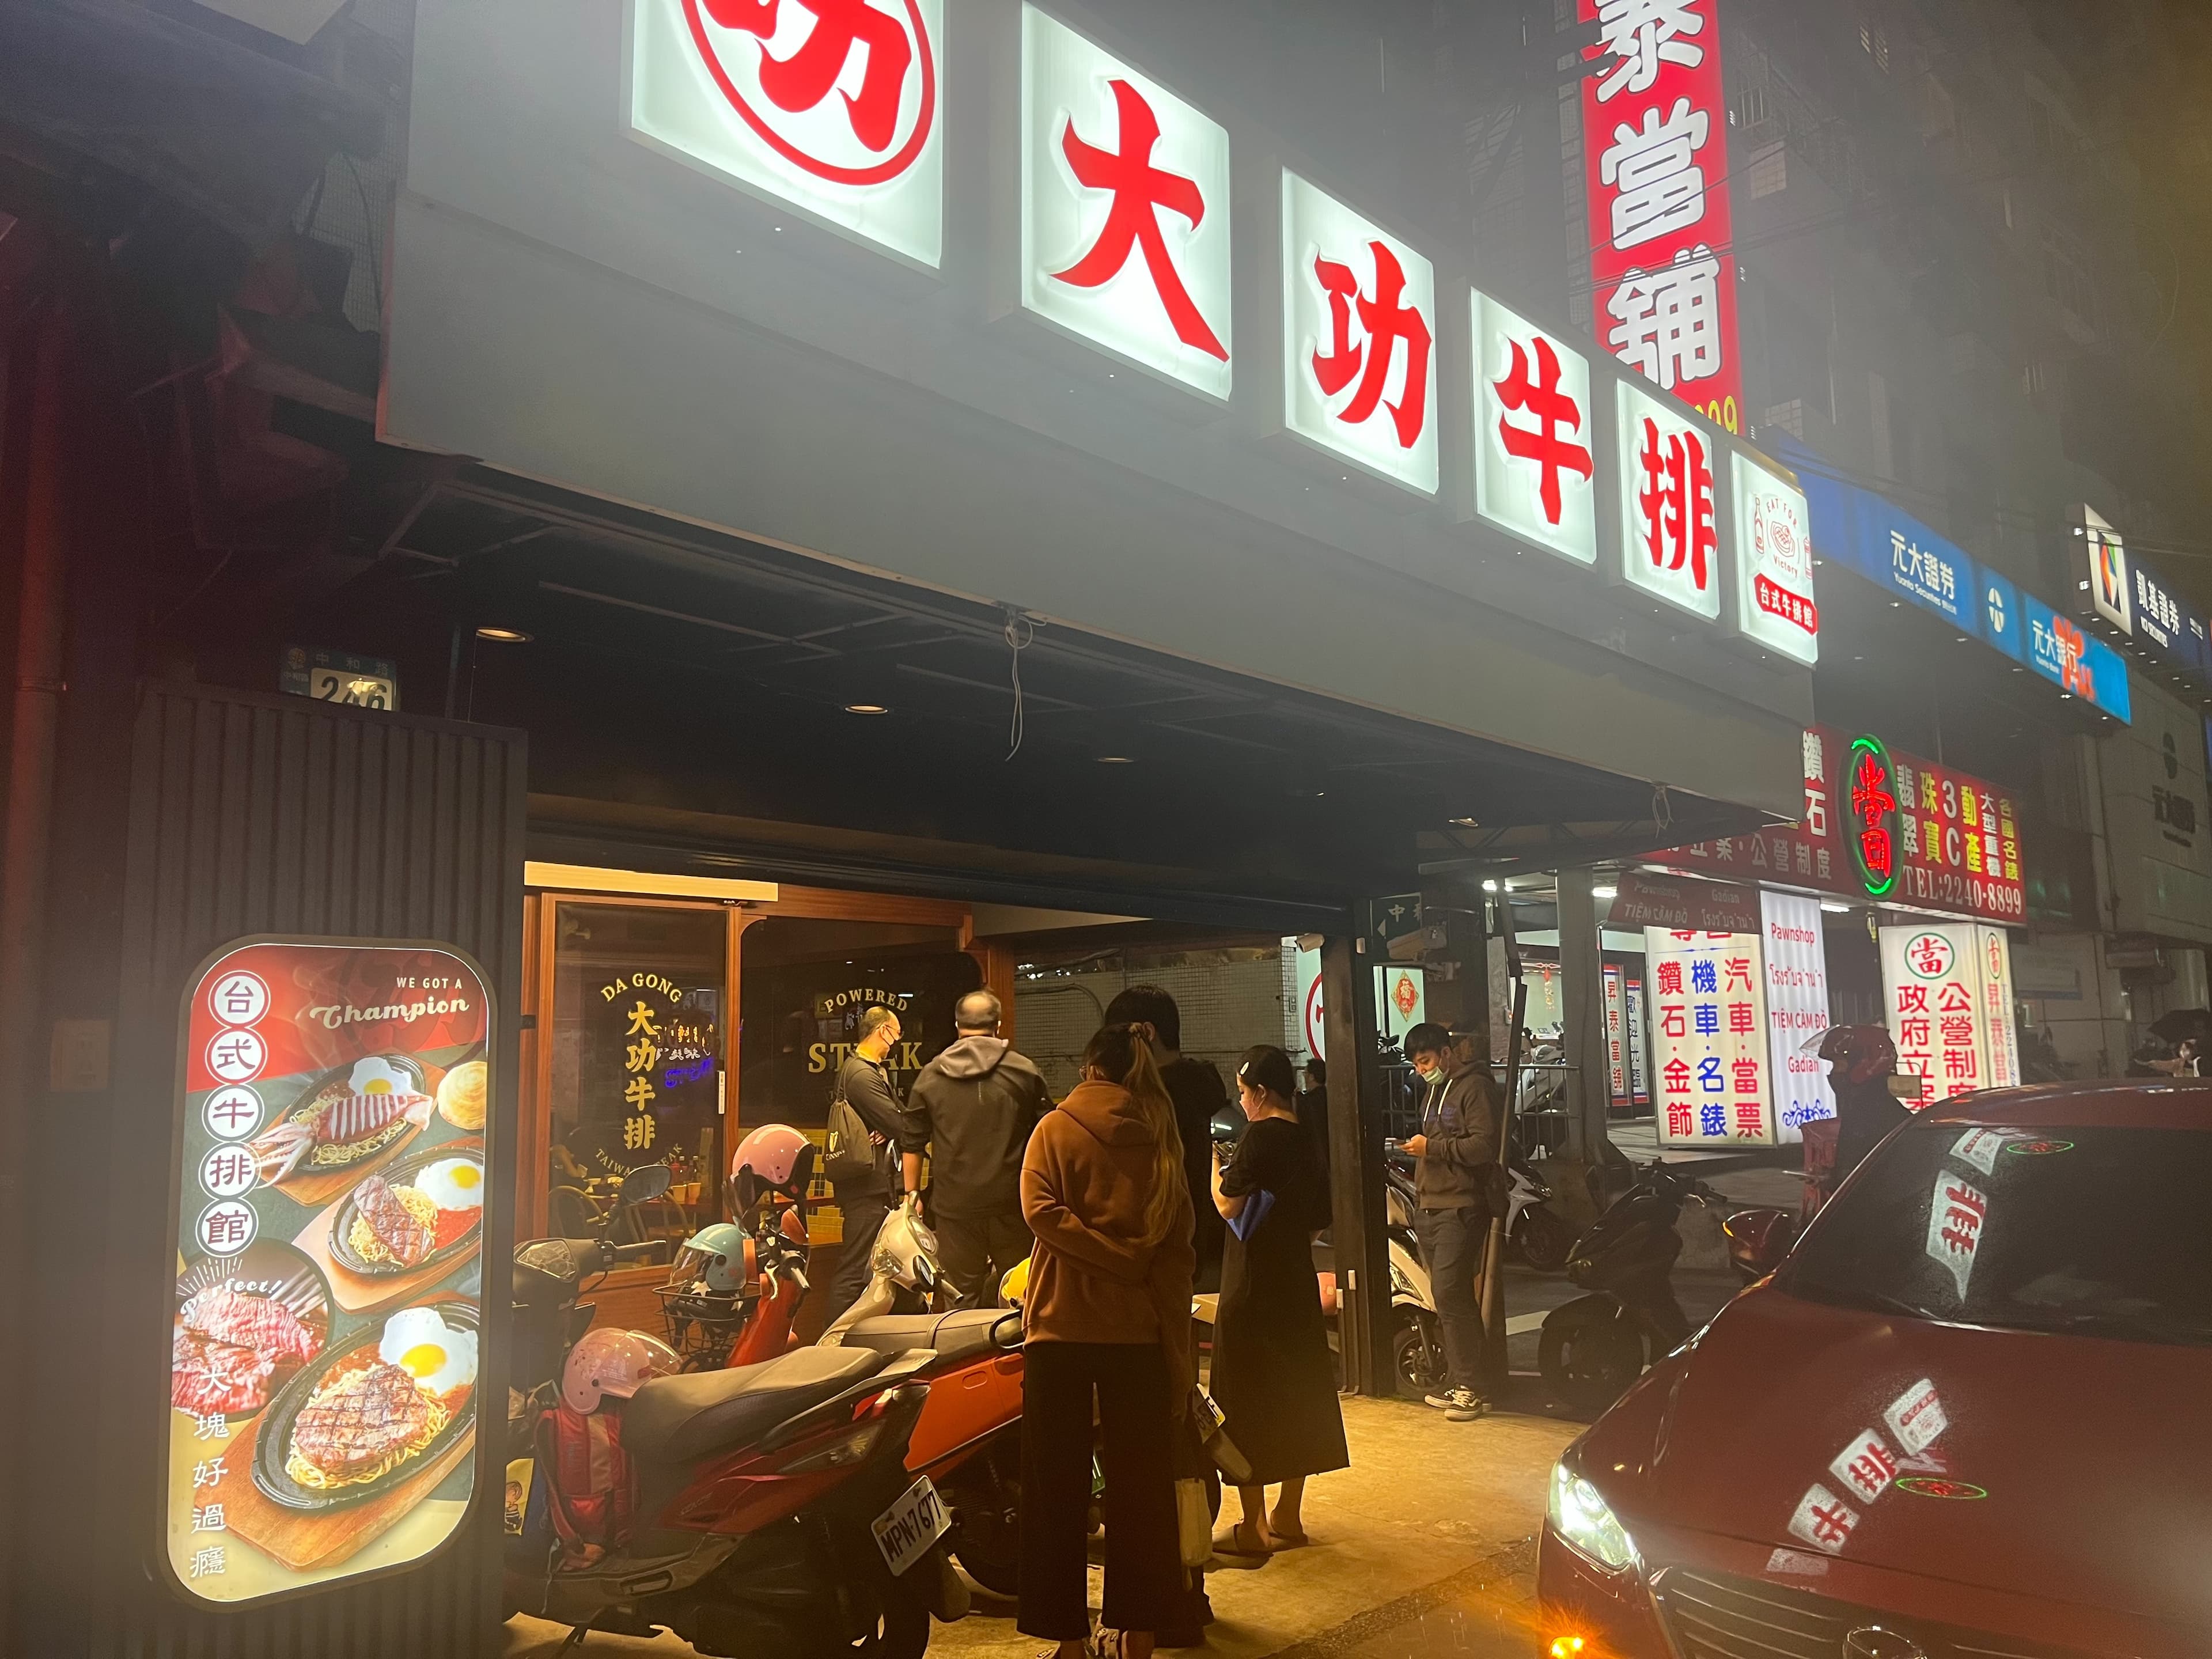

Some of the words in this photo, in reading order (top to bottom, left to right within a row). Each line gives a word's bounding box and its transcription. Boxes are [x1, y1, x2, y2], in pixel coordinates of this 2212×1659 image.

[1048, 79, 1718, 590] 大功牛排
[1766, 498, 1779, 514] EAT
[1773, 554, 1798, 579] Victory
[1890, 529, 1955, 600] 元大證券
[1760, 582, 1814, 628] 台式牛排館
[2032, 619, 2077, 673] 元大銀行
[1852, 754, 1896, 878] 當
[1919, 771, 1942, 865] 珠寶
[1942, 780, 1961, 867] 3C
[1960, 785, 1982, 873] 動產
[1770, 922, 1815, 948] Pawnshop
[1911, 937, 1948, 974] 當
[396, 977, 415, 988] WE
[422, 978, 449, 989] GOT
[454, 978, 462, 989] A
[601, 978, 628, 1002] DA
[632, 972, 683, 1003] GONG
[824, 988, 908, 1014] POWERED
[309, 995, 470, 1029] Champion
[1771, 1008, 1794, 1033] TIỆM
[624, 1001, 659, 1150] 大功牛排
[808, 1042, 922, 1074] STK
[1788, 1055, 1819, 1074] Gadian
[206, 981, 255, 1244] 台式牛排館
[595, 1148, 635, 1176] TAIWA
[190, 1369, 230, 1578] 大塊好過癮
